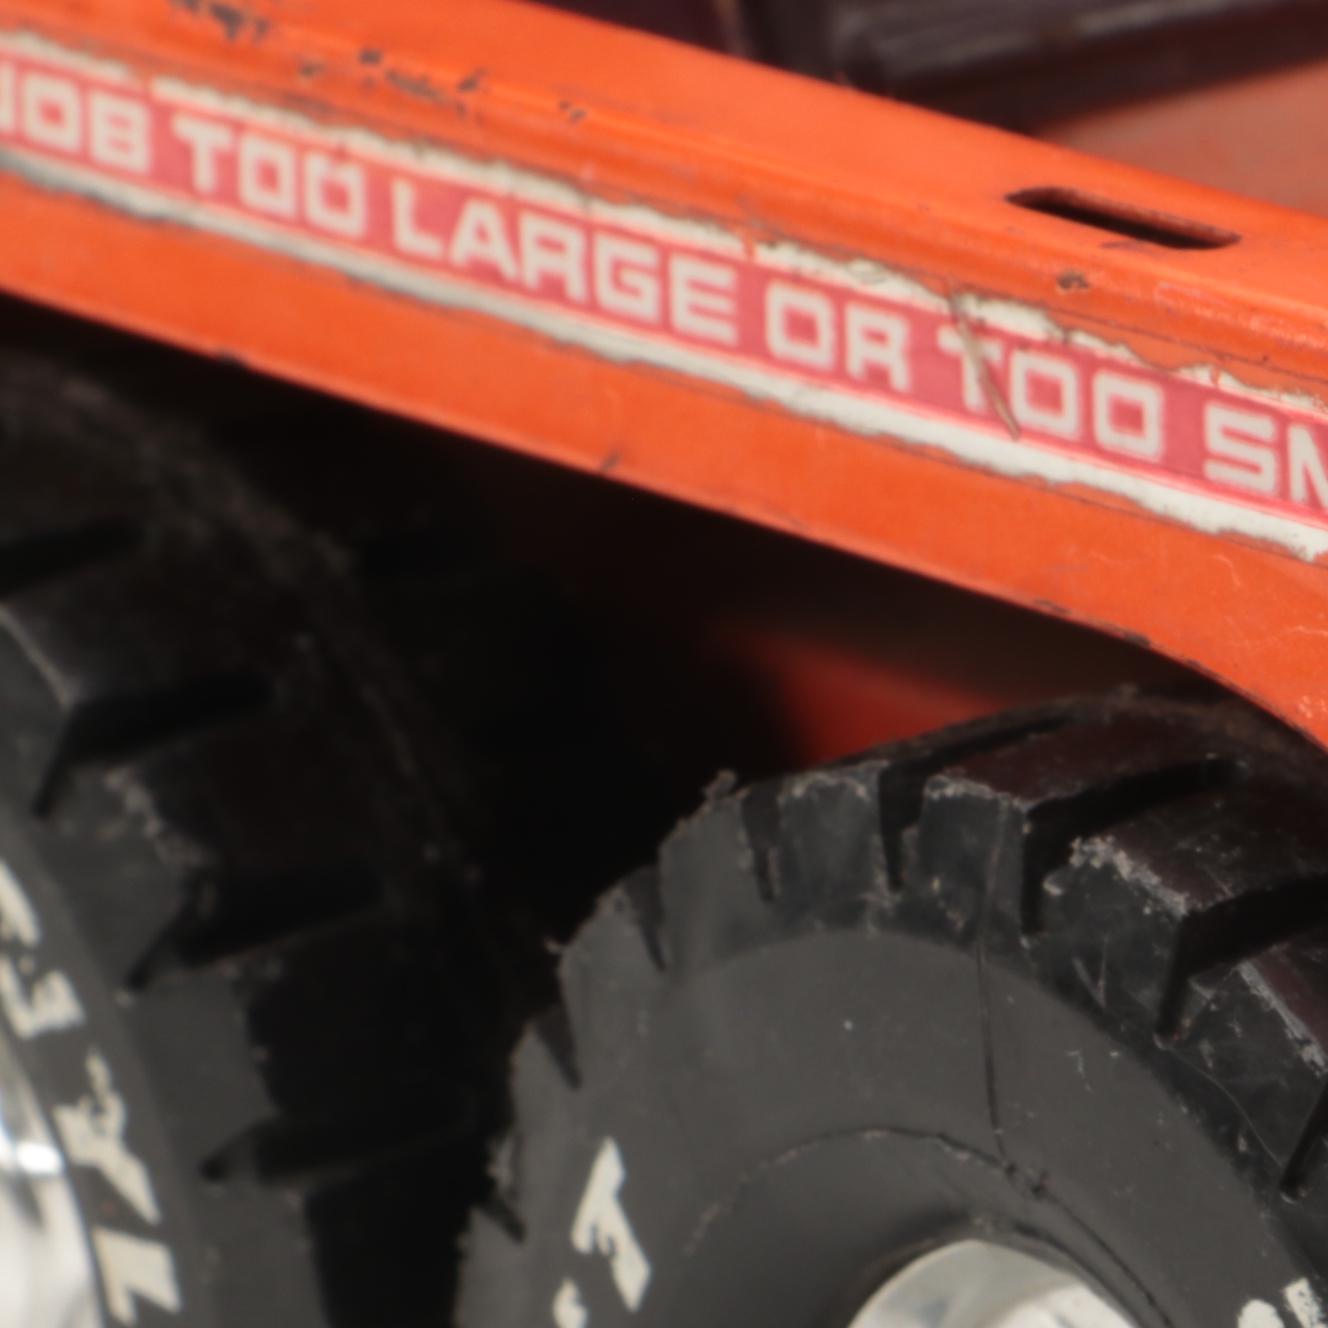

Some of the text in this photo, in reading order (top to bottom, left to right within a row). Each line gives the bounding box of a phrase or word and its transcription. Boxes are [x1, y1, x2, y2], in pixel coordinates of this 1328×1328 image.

[0, 62, 151, 175] OB
[172, 114, 367, 238] TOO
[393, 178, 738, 346] LARGE
[764, 280, 912, 393] OR
[937, 318, 1164, 463] TOO
